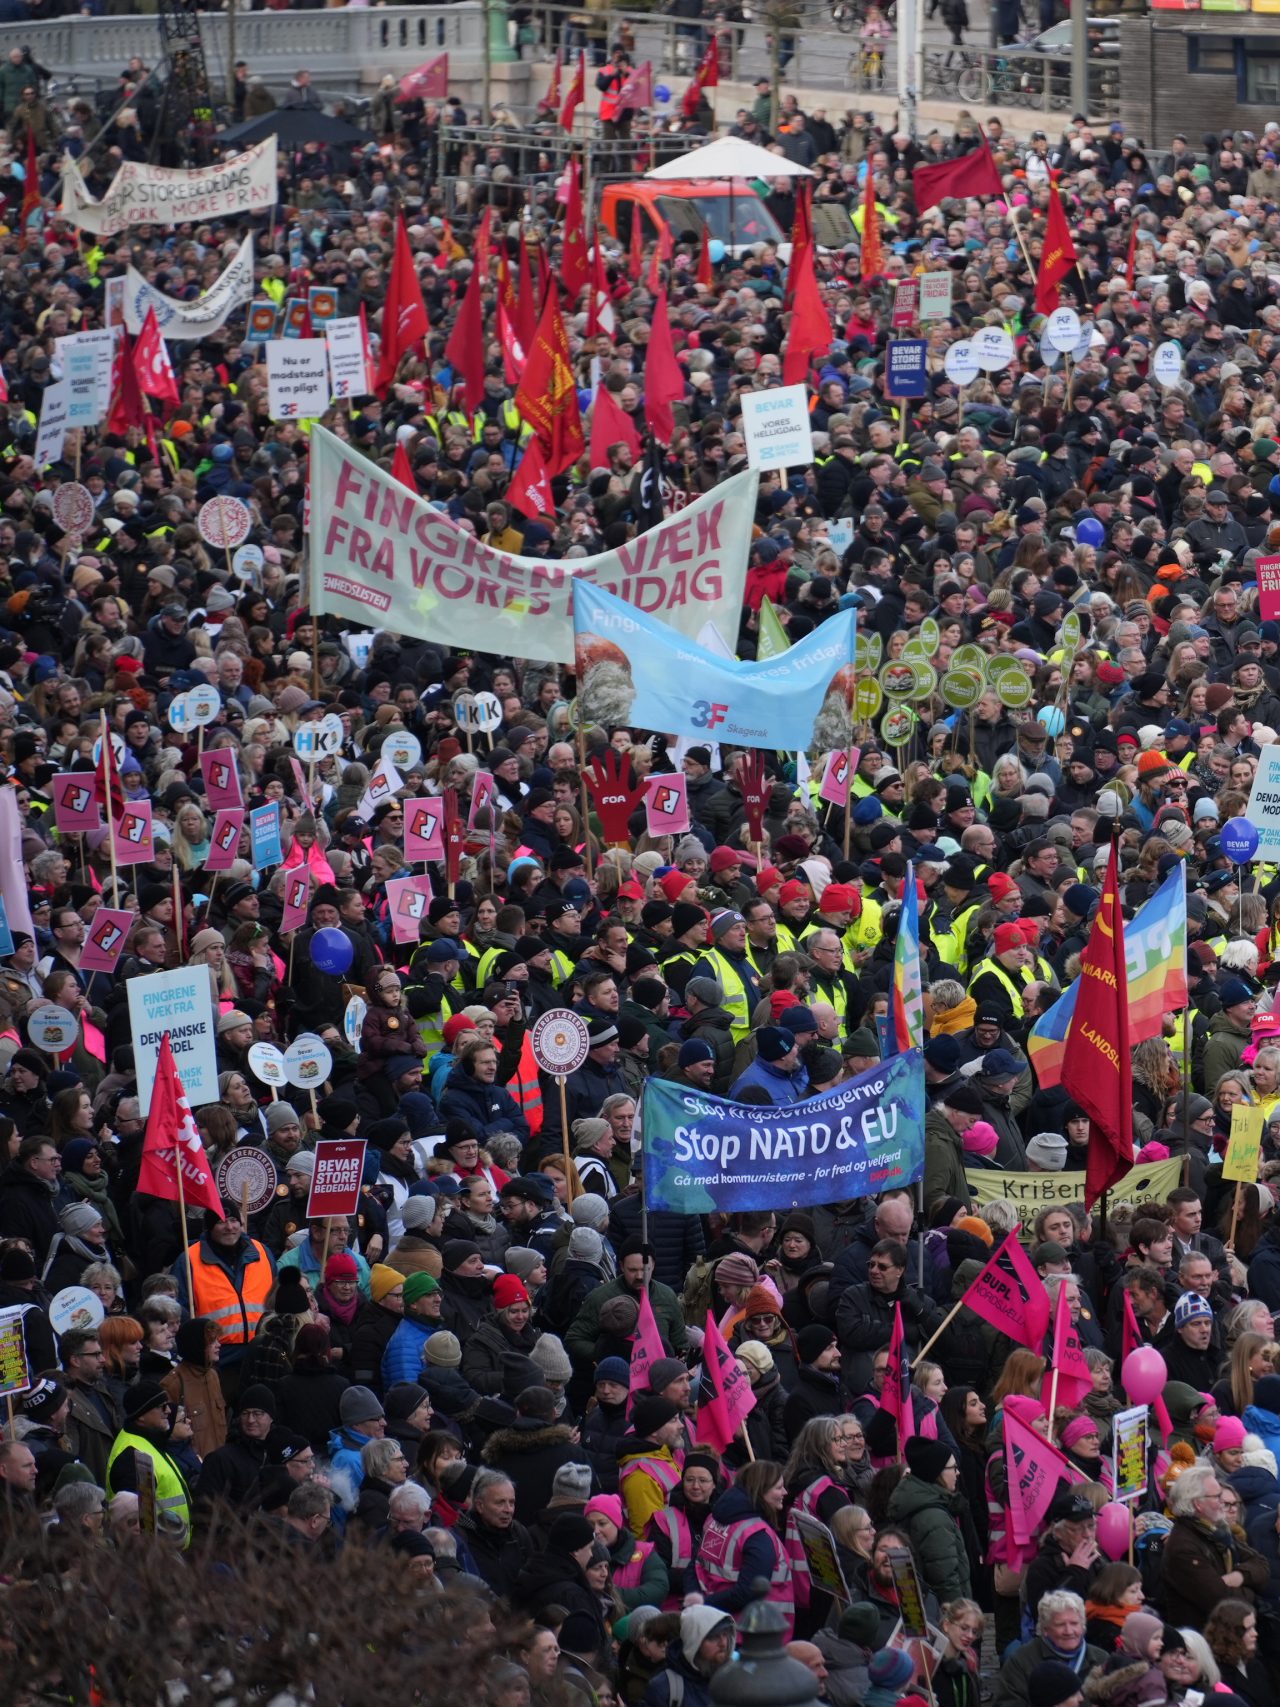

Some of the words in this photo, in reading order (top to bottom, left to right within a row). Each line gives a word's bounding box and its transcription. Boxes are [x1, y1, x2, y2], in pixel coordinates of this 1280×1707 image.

[172, 197, 219, 217] MORE
[226, 184, 270, 205] PRAY
[892, 346, 921, 355] BEVAR
[282, 357, 297, 365] Nu
[891, 355, 921, 364] STORE
[270, 370, 324, 379] modstand
[293, 383, 318, 394] pligt
[280, 402, 298, 416] 3F
[755, 399, 793, 413] BEVAR
[762, 418, 791, 429] VORES
[754, 425, 802, 439] HELLIGDAG
[334, 459, 598, 591] FINGRENE
[616, 500, 724, 576] VÆK
[325, 516, 394, 581] FRA
[409, 545, 550, 616] VORES
[1261, 571, 1277, 580] FRA
[456, 704, 480, 725] HK
[690, 700, 729, 729] 3F
[727, 723, 769, 738] Skagerak
[299, 733, 329, 754] HK
[602, 795, 626, 805] FOA
[747, 795, 760, 803] FOA
[1255, 792, 1273, 803] DEN
[1226, 840, 1250, 849] BEVAR
[143, 985, 196, 1006] FINGRENE
[147, 1005, 172, 1019] VÆK
[174, 1001, 194, 1015] FRA
[140, 1030, 162, 1046] DEN
[164, 1022, 207, 1040] DANSKE
[535, 1013, 554, 1052] BALLERUP
[557, 1011, 587, 1067] LÆRERFORENING
[1079, 1022, 1120, 1073] LANDSL
[684, 1097, 724, 1121] Stop
[674, 1126, 740, 1169] Stop
[750, 1123, 831, 1160] NATO
[836, 1116, 857, 1150] &
[861, 1103, 898, 1144] EU
[227, 1149, 274, 1190] LÆRERFORENING
[318, 1158, 360, 1173] BEVAR
[674, 1174, 691, 1186] Gå
[694, 1173, 719, 1185] med
[721, 1171, 805, 1184] kommunisterne
[814, 1166, 831, 1181] for
[832, 1162, 852, 1179] fred
[853, 1162, 866, 1175] og
[868, 1149, 901, 1168] velfærd
[316, 1170, 358, 1184] STORE
[314, 1182, 357, 1194] BEDEDAG
[982, 1272, 1012, 1300] BUPL
[974, 1283, 1028, 1328] NORDSJÆLLA
